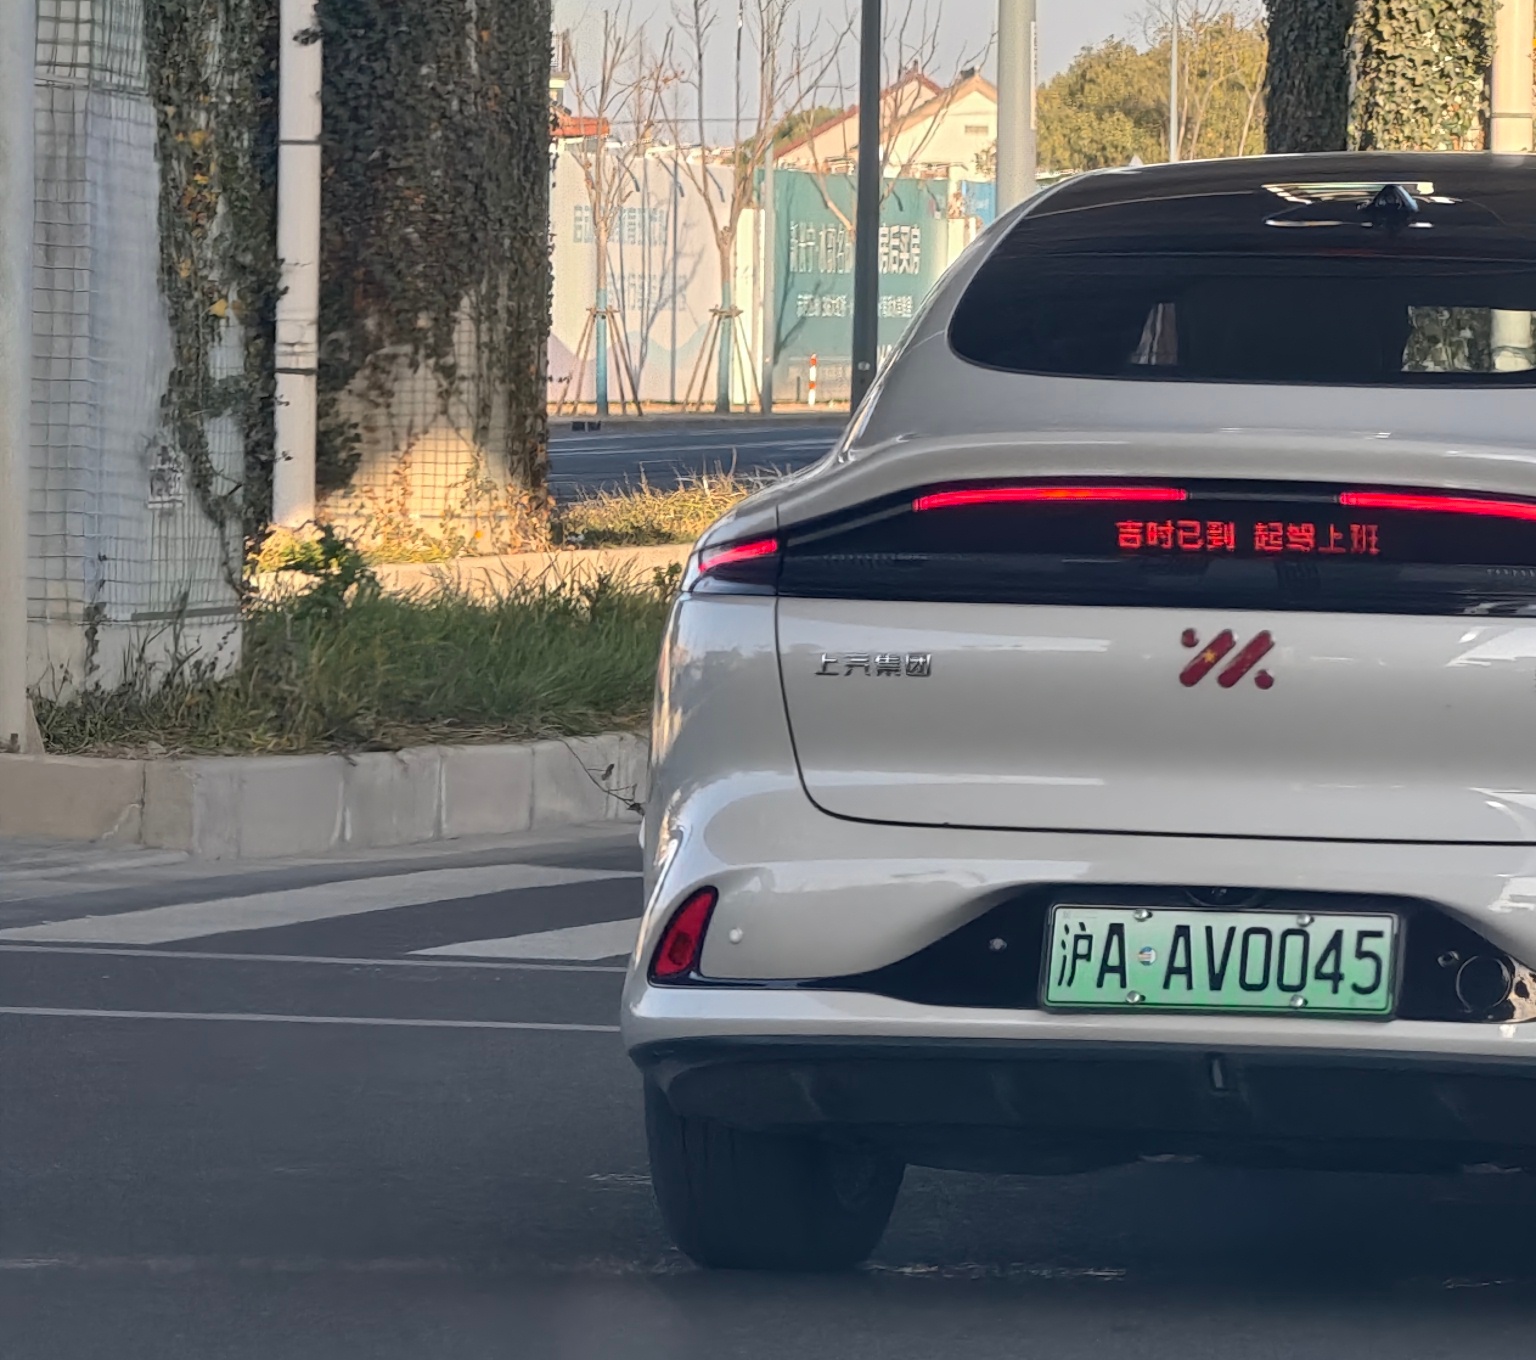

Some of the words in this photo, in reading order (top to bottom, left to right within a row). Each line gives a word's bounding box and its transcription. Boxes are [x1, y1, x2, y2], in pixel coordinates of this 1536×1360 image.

[1116, 520, 1236, 551] 吉时已到
[1254, 522, 1380, 554] 起驾上班
